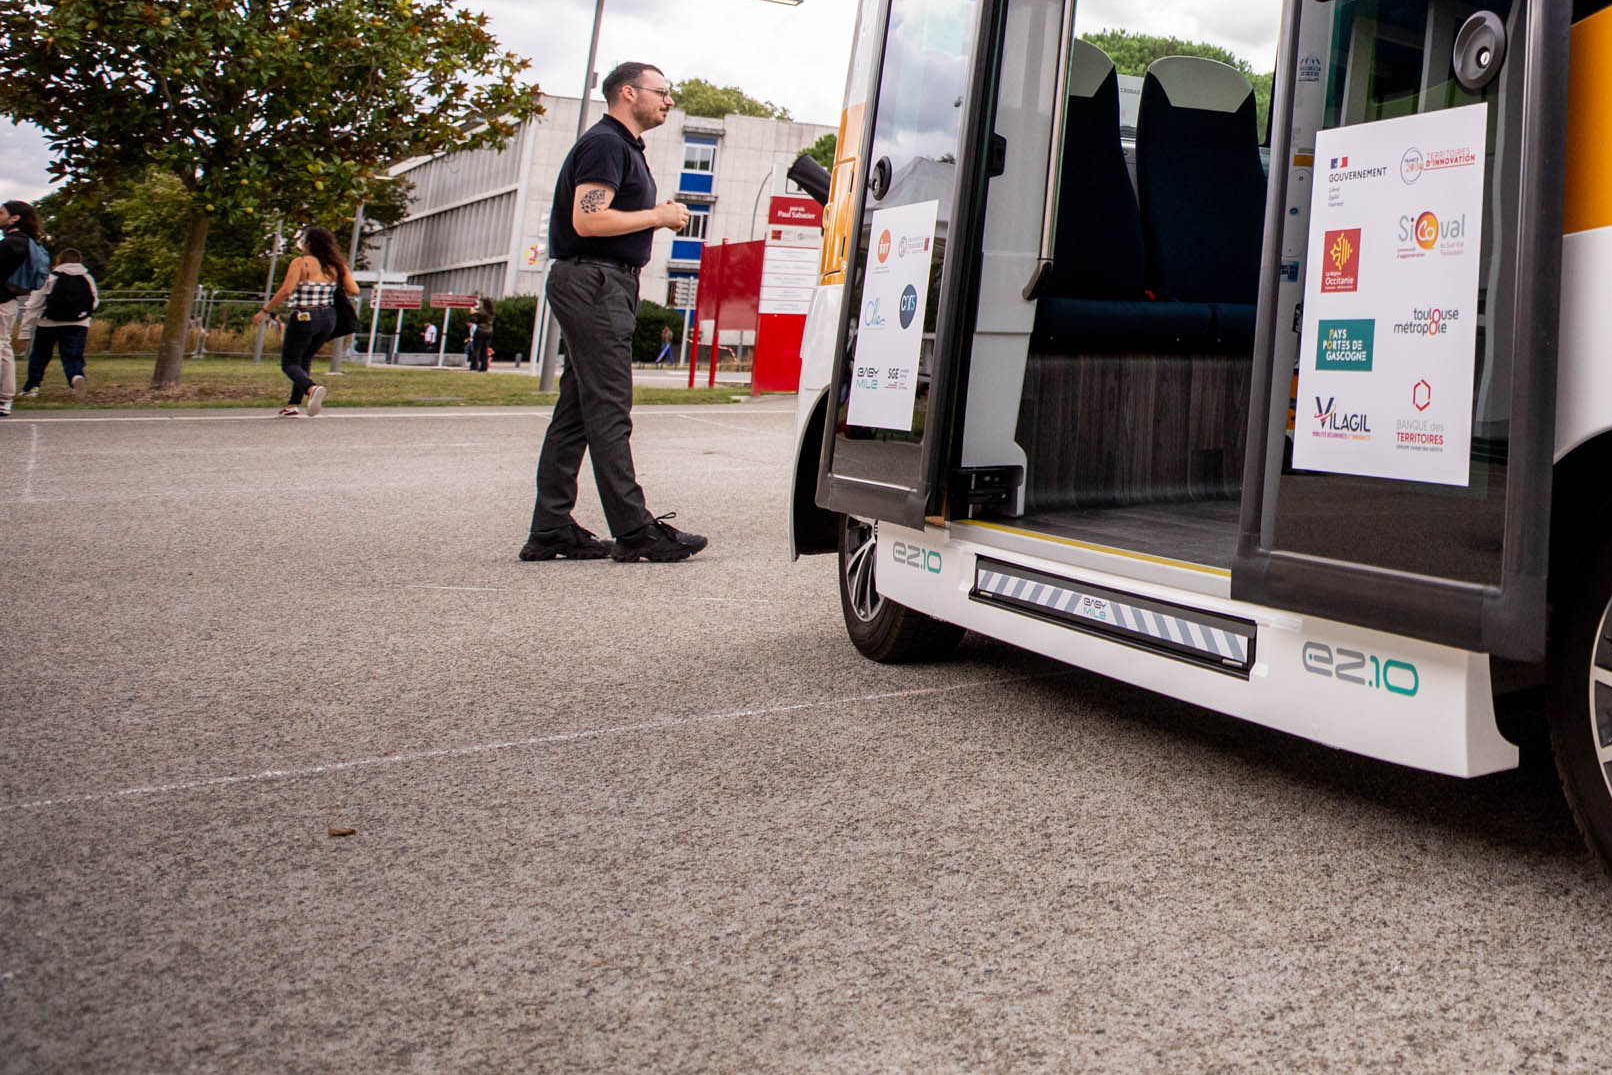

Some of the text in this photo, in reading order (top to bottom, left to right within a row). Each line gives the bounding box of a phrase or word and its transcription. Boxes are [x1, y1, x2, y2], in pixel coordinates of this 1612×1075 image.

[1426, 154, 1475, 166] D'INNOVATION
[1328, 167, 1387, 182] GOUVERNEMENT
[1325, 277, 1354, 286] Occitanie
[1413, 307, 1459, 323] toulouse
[1329, 329, 1347, 340] PAYS
[1322, 340, 1363, 350] PORTES DE
[1326, 351, 1367, 361] GASCOGNE
[888, 368, 899, 379] SGE
[1314, 396, 1371, 432] VILAGIL
[1396, 419, 1428, 432] BANQUE
[1396, 432, 1444, 445] TERRITOIRES
